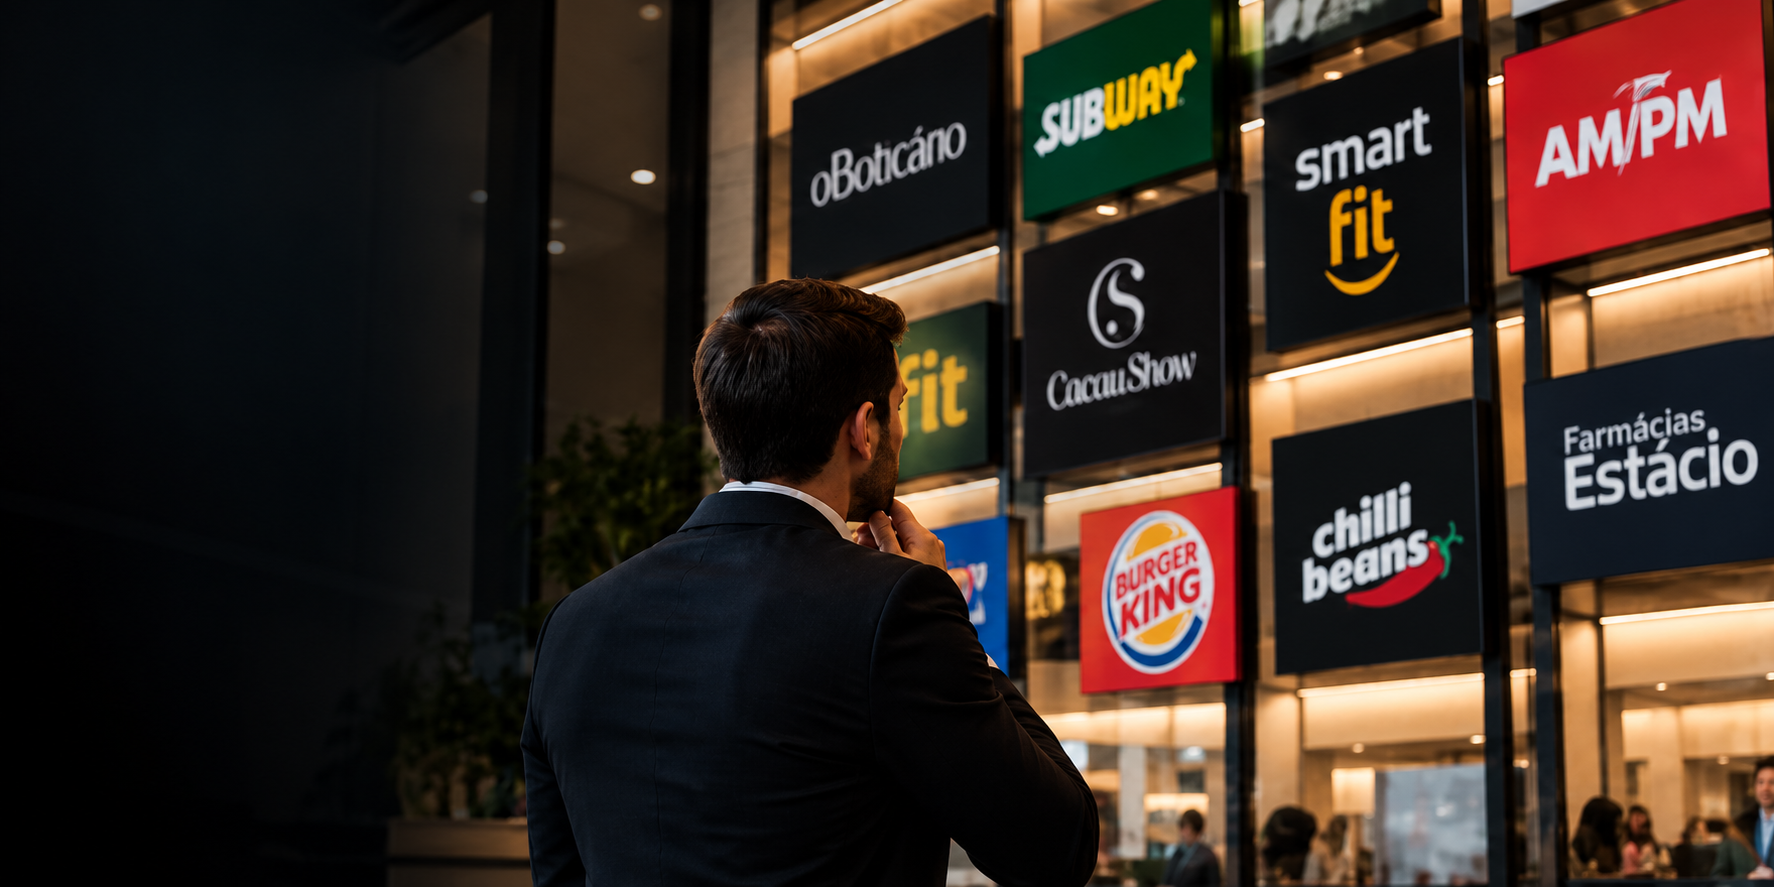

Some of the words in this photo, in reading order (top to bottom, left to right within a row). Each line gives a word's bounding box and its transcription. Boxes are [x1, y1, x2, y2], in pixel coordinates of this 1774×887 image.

[1033, 48, 1198, 158] SUBWAY
[1295, 106, 1432, 191] smart
[1329, 184, 1395, 267] fit
[898, 348, 968, 439] fit
[1563, 407, 1706, 455] Farmácias
[1564, 427, 1759, 511] Estácio
[1312, 481, 1412, 558] chilli
[1116, 541, 1198, 601] BURGER
[1119, 567, 1201, 640] KING
[1302, 529, 1430, 604] beans
